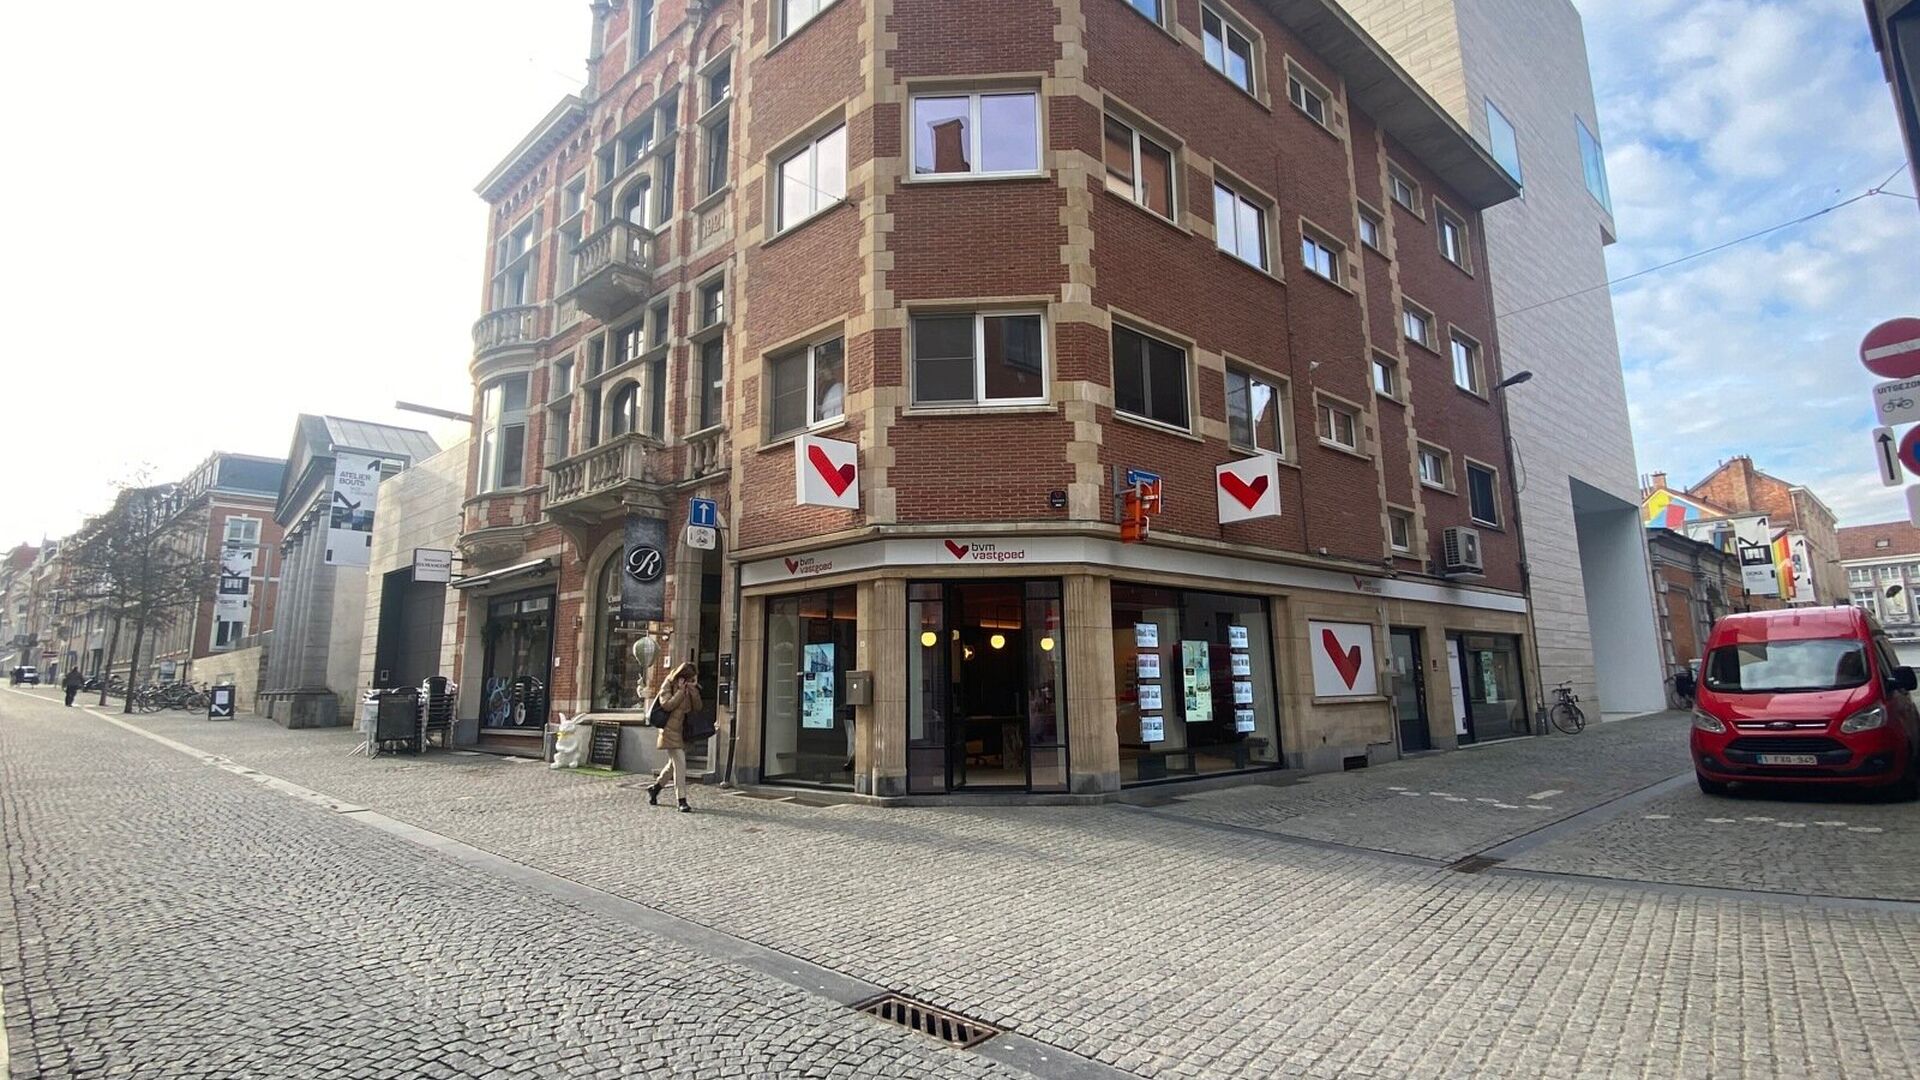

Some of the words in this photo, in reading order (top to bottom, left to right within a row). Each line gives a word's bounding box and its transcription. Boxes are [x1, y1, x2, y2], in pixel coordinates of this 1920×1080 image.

[340, 471, 371, 481] ATELIER
[339, 478, 366, 487] BOUTS
[971, 543, 996, 552] bvm
[972, 549, 1025, 562] vastgoed
[626, 547, 662, 579] R
[800, 557, 815, 566] bvm
[800, 561, 833, 574] vastgoed
